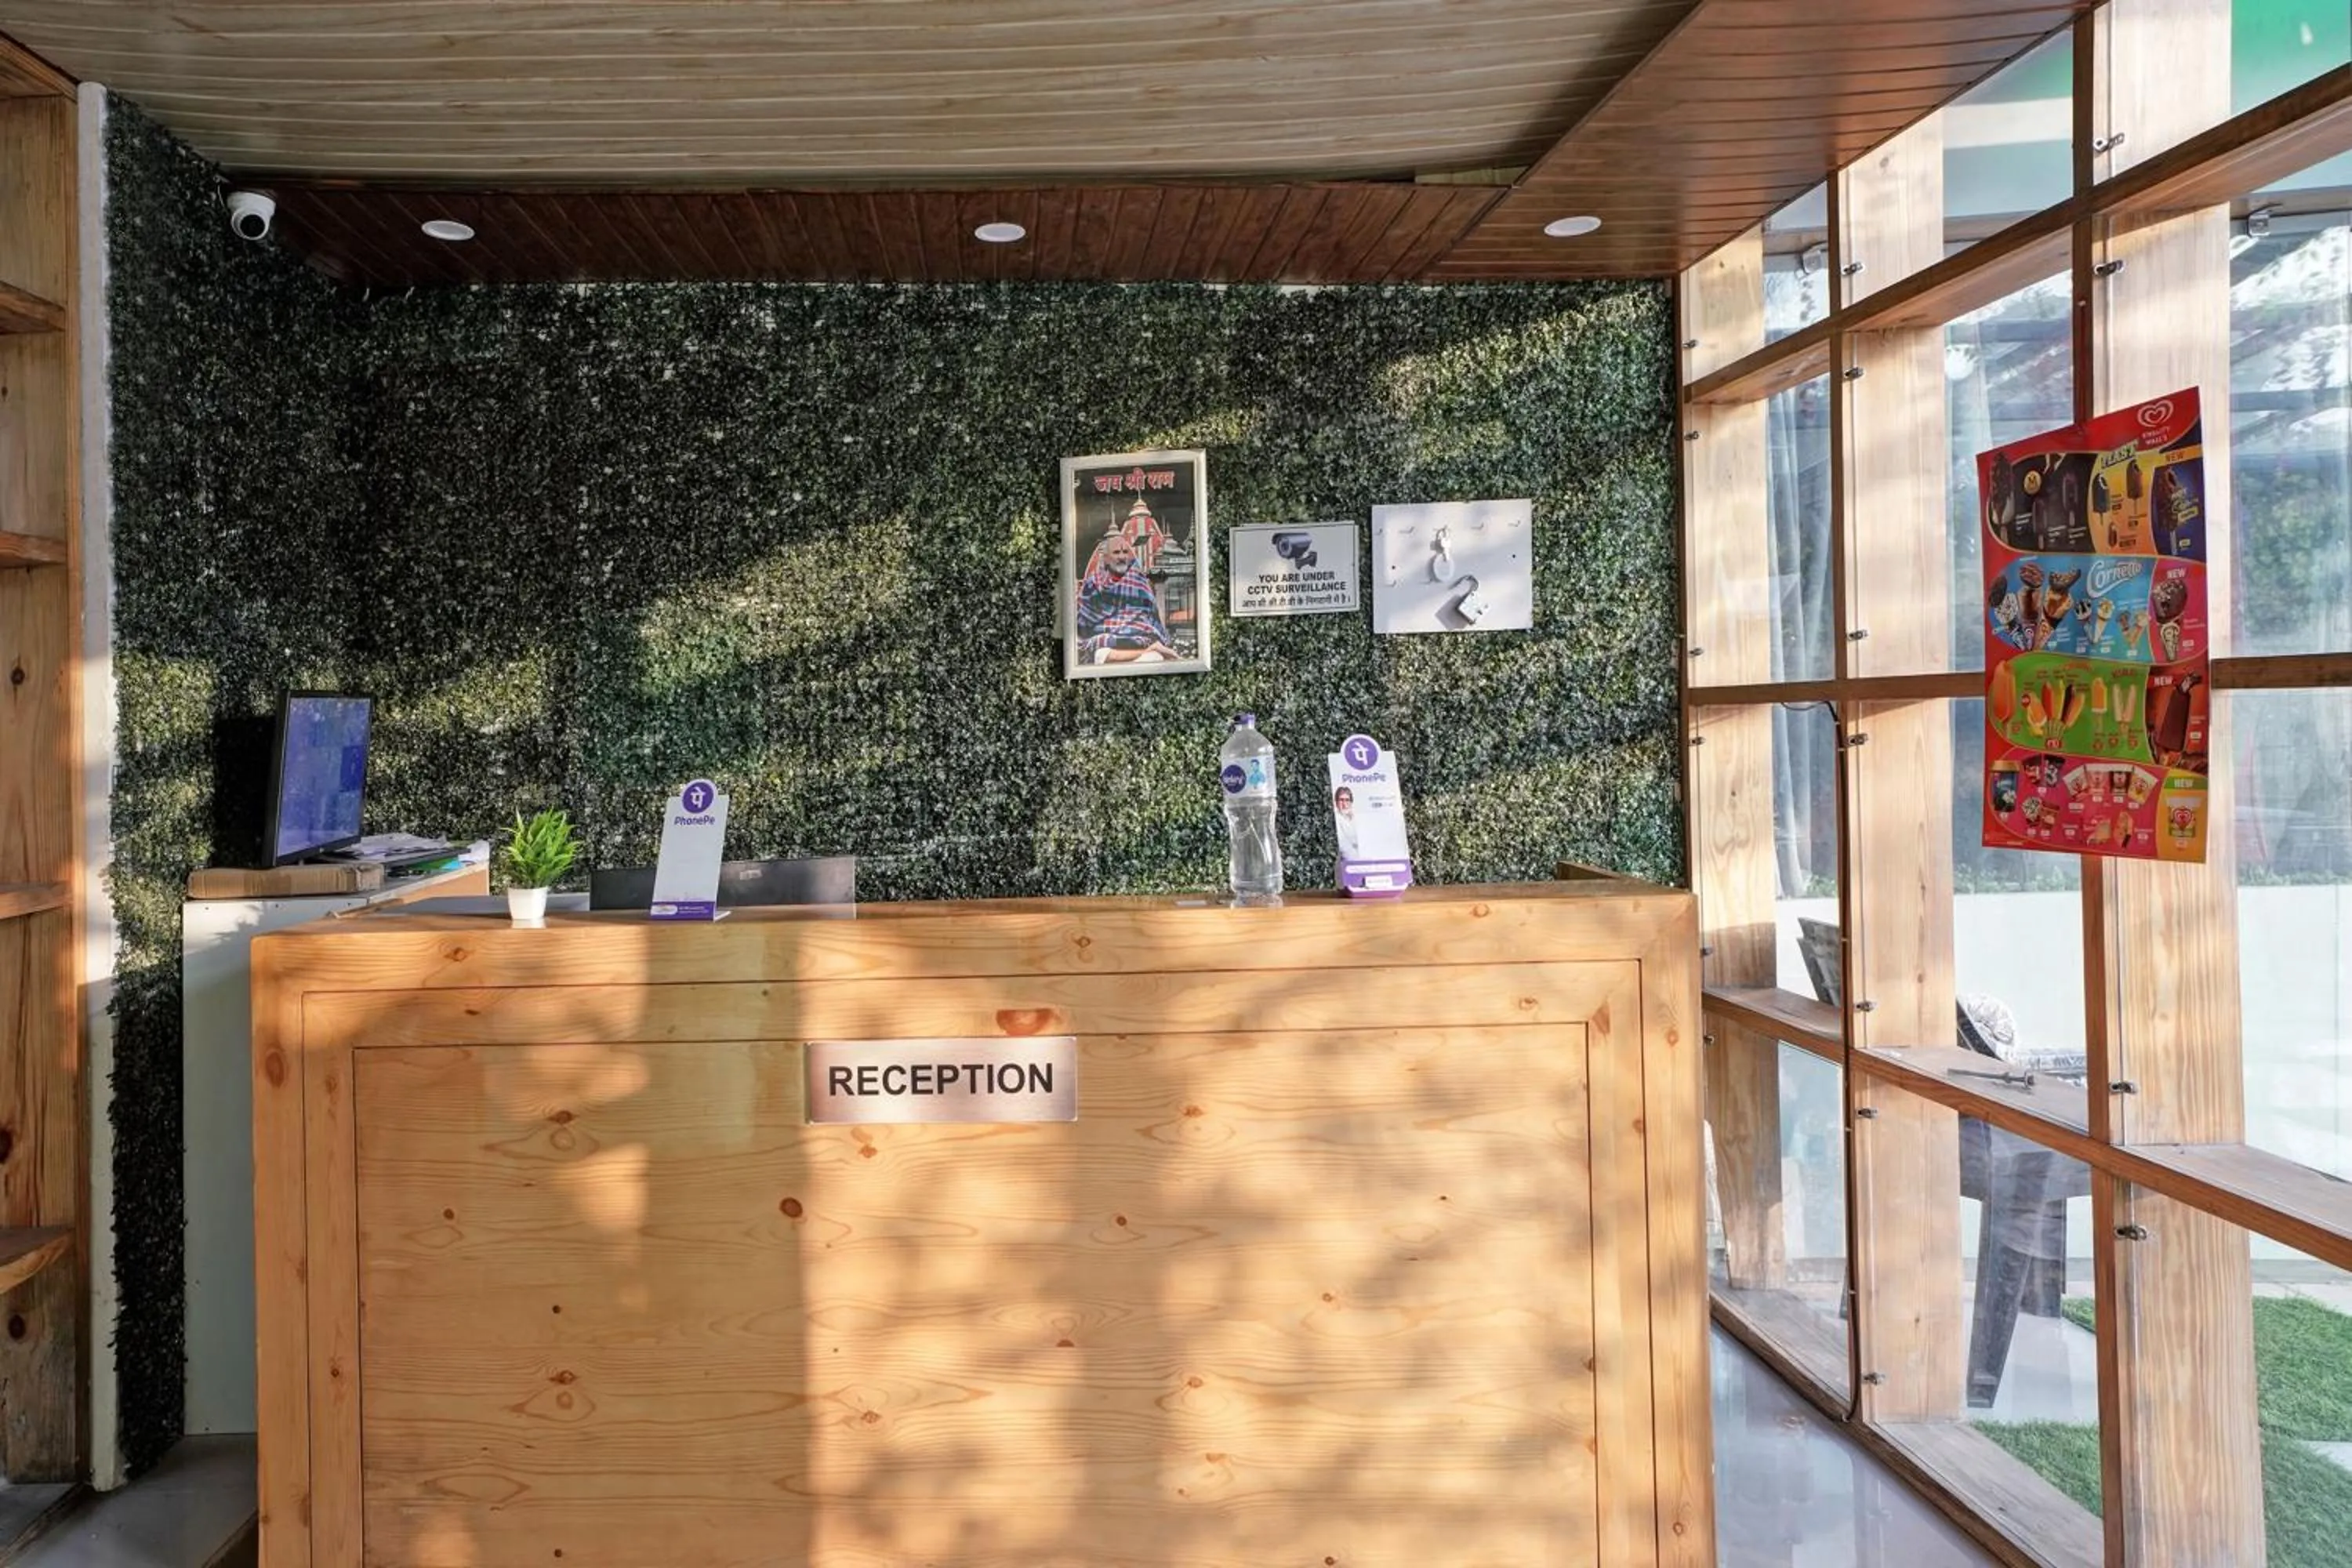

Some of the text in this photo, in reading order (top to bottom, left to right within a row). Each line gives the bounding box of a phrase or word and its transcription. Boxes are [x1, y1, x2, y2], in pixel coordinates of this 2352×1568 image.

[1146, 470, 1175, 490] राम
[1259, 572, 1335, 583] YOU ARE UNDER
[2087, 560, 2142, 598] Cornetto
[2166, 568, 2187, 579] NEW
[1247, 582, 1347, 595] CCTV SURVEILLANCE
[2154, 677, 2173, 687] NEW
[1341, 773, 1387, 783] PhonePe
[673, 815, 716, 826] PhonePe
[828, 1062, 1054, 1097] RECEPTION
